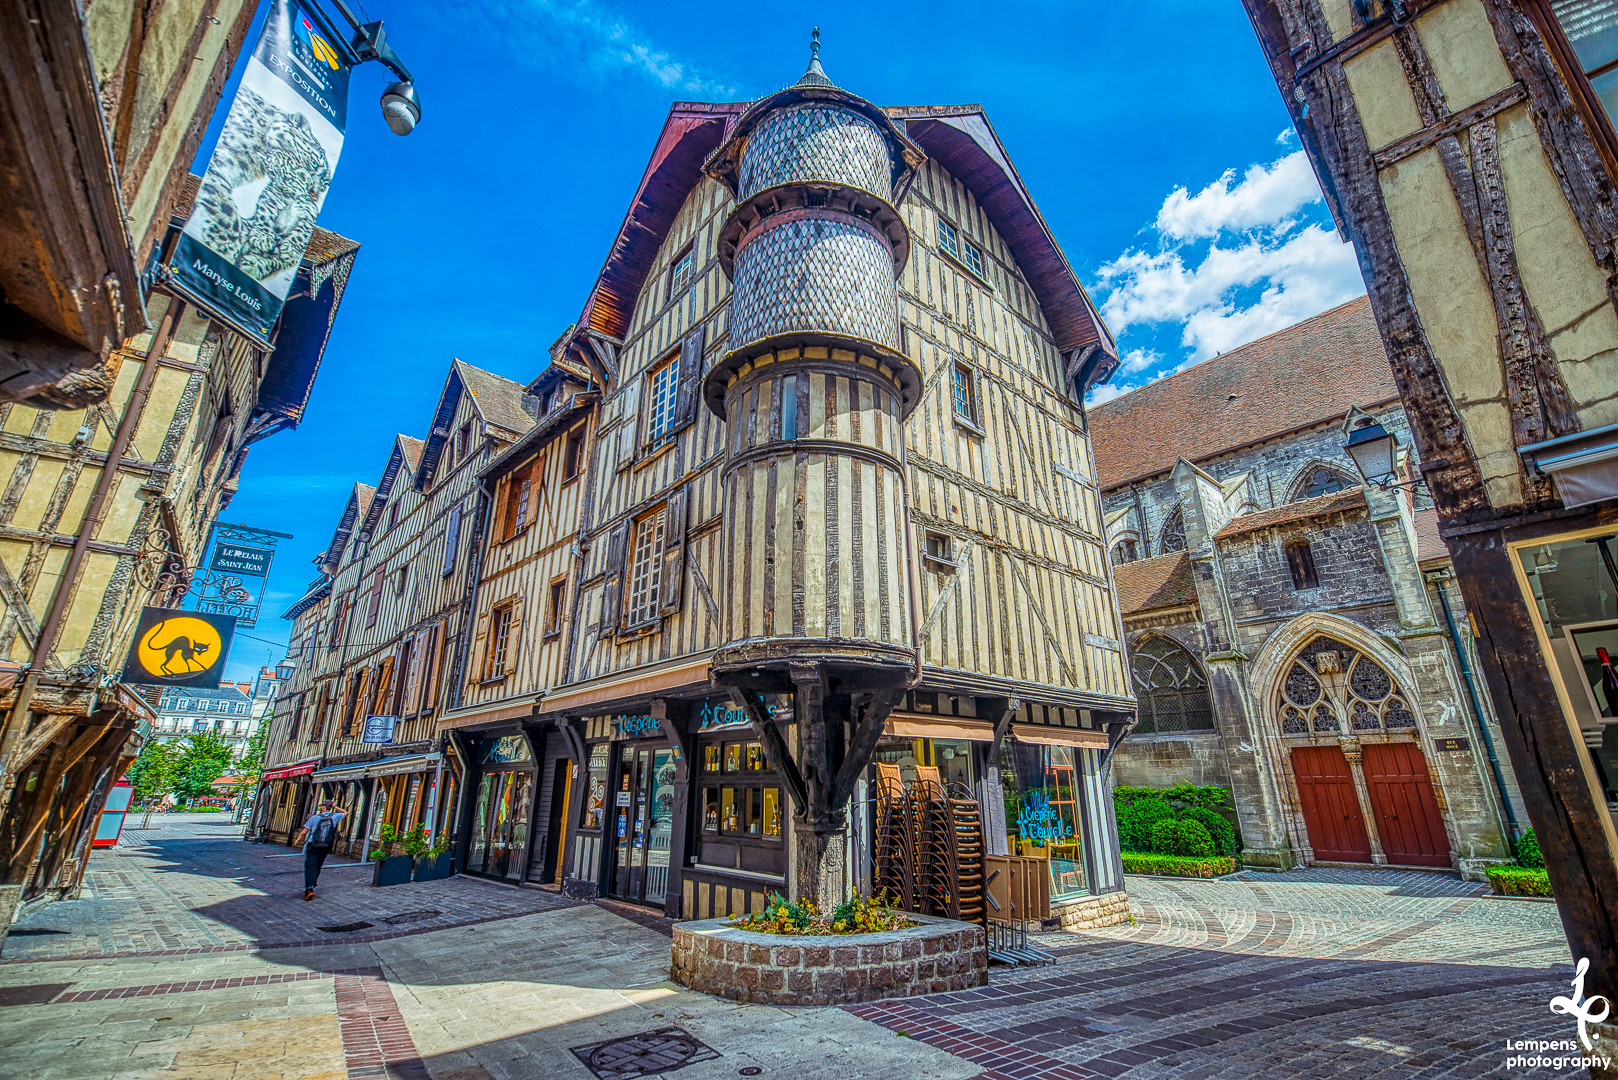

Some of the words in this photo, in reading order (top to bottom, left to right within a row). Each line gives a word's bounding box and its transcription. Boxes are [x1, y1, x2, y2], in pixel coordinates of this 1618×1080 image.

[302, 47, 328, 77] maison
[270, 53, 337, 118] EXPOSITION
[192, 258, 235, 292] Maryse
[234, 286, 262, 311] Louis
[1028, 818, 1072, 839] Tourelle
